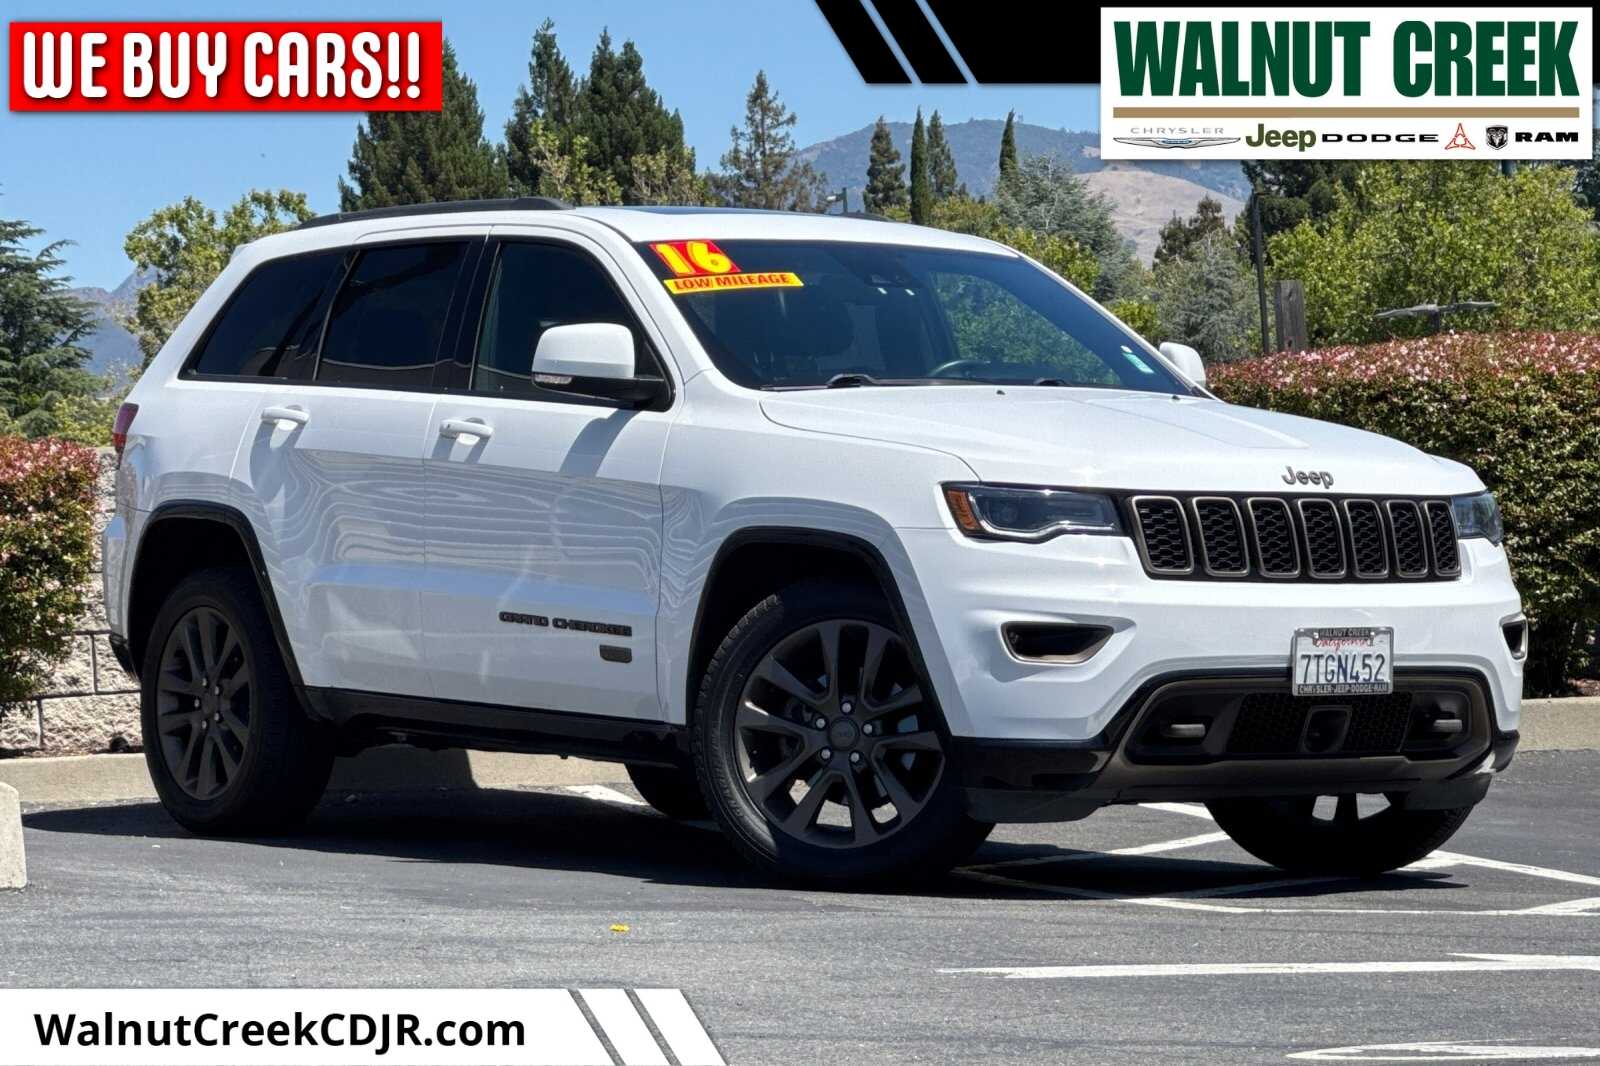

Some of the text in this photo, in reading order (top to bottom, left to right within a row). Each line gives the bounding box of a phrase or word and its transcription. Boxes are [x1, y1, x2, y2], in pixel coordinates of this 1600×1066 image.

[655, 240, 733, 274] 16
[673, 273, 791, 291] LOW MILEAGE
[1282, 465, 1334, 489] Jeep
[499, 611, 549, 627] GRAND
[1300, 653, 1386, 684] 7TGN452
